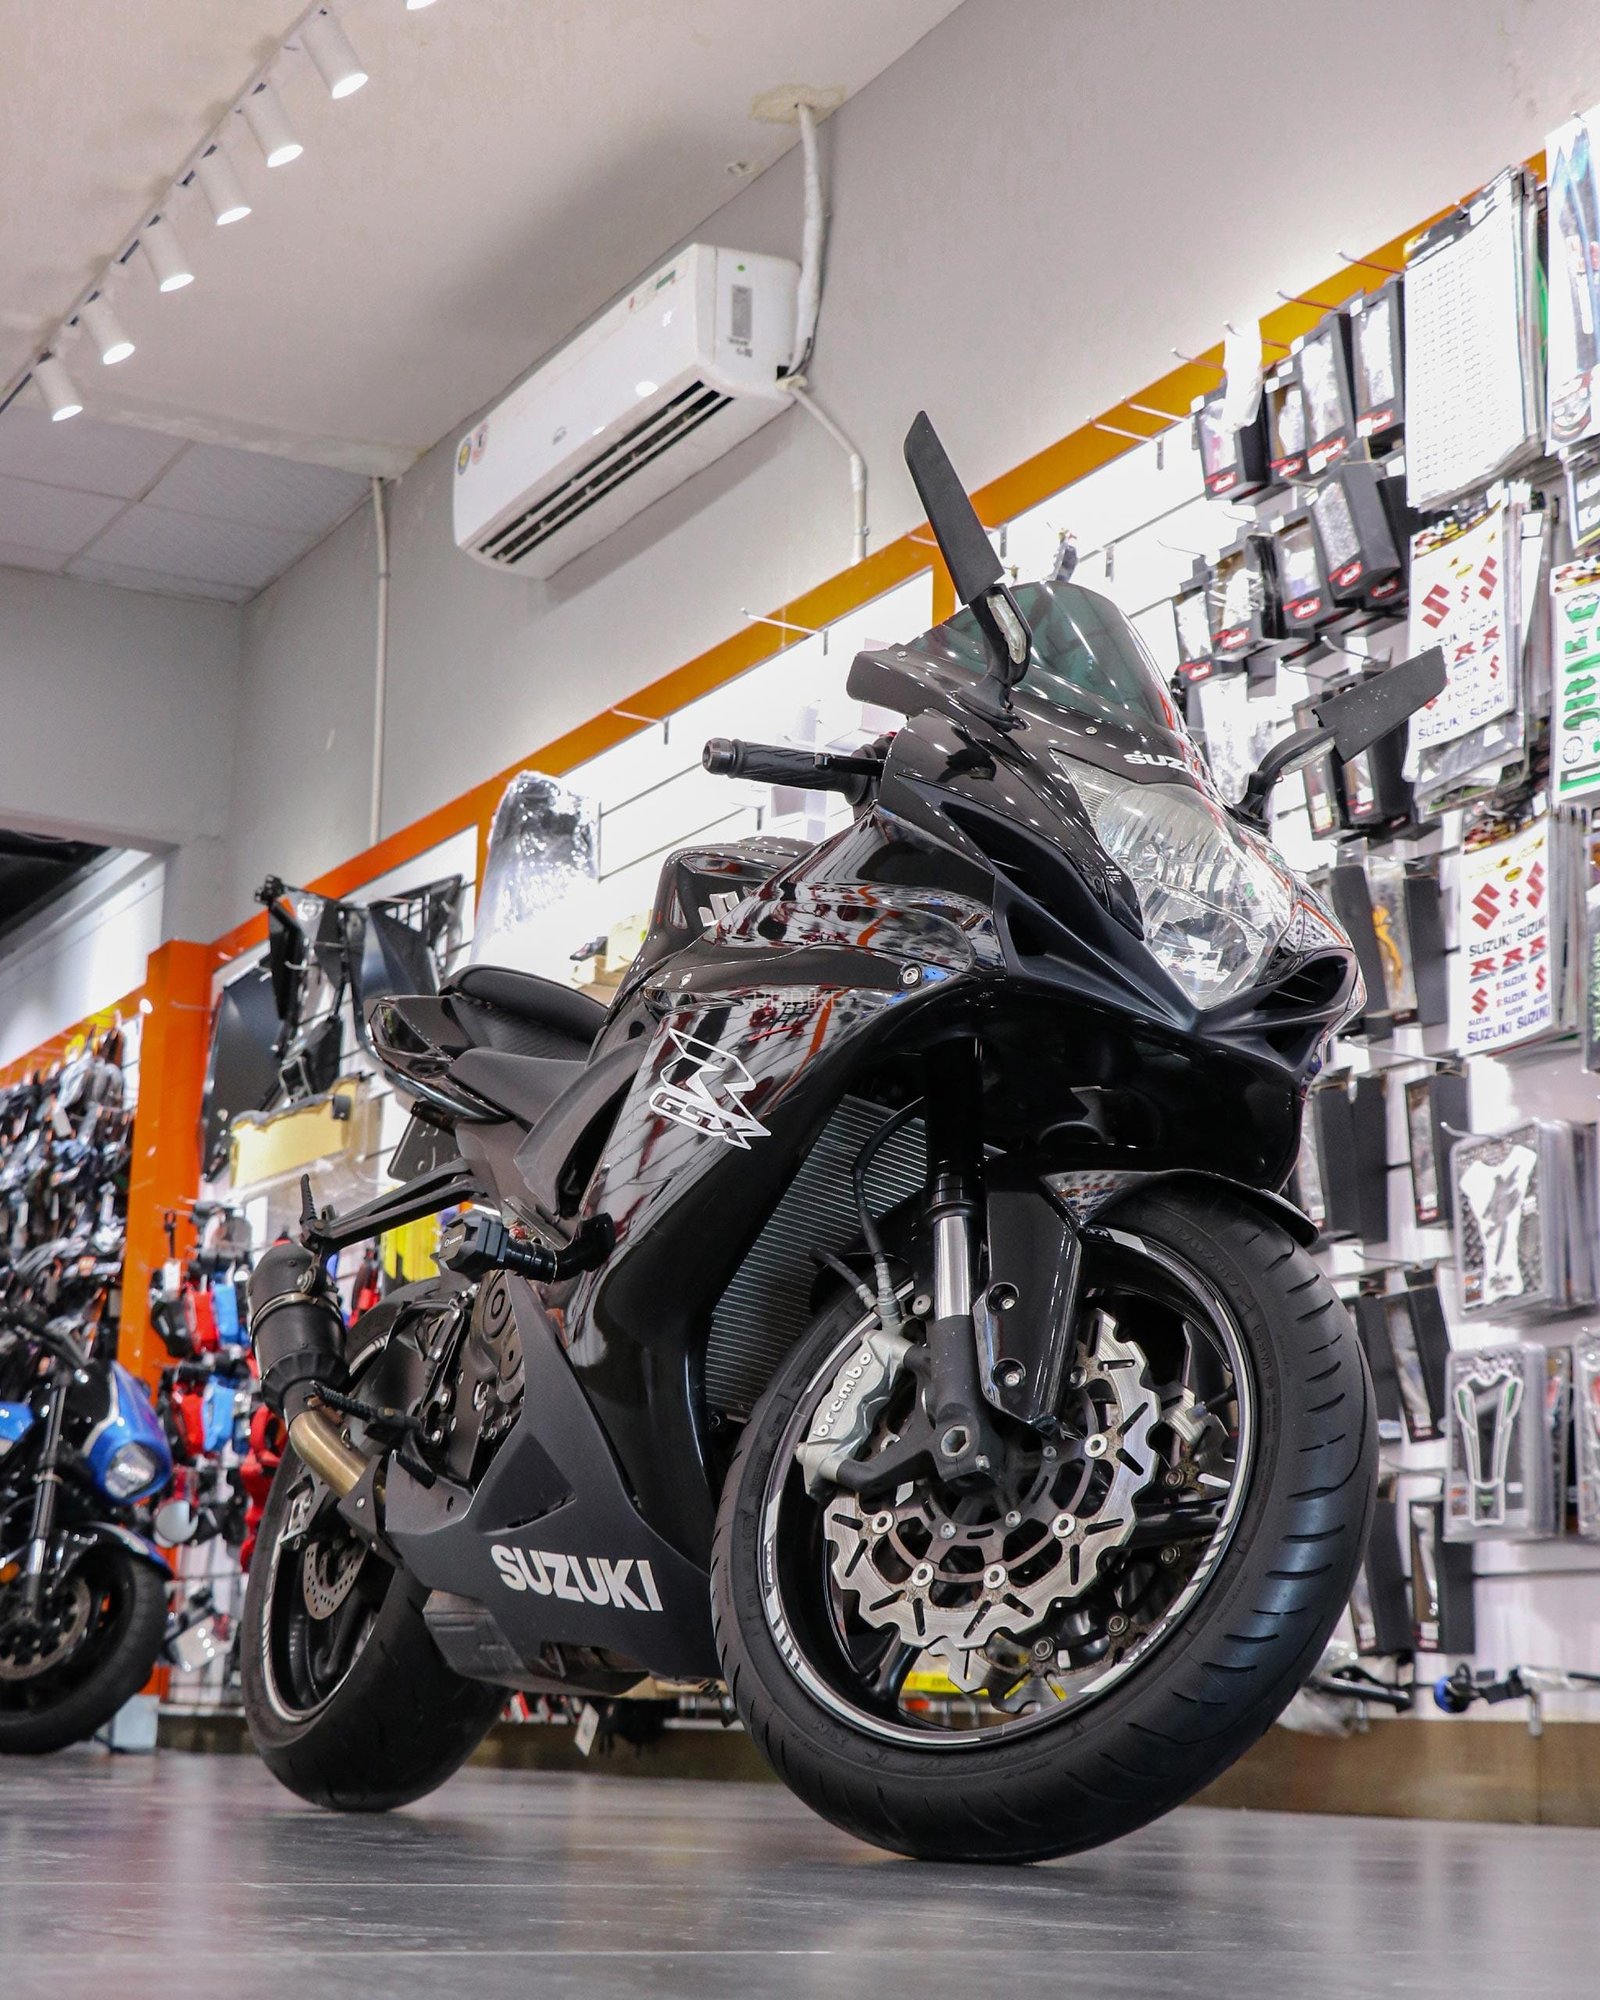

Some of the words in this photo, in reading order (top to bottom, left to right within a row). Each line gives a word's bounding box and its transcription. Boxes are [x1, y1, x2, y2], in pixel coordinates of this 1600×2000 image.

[1468, 933, 1513, 958] SUZUKI
[1466, 1021, 1513, 1045] SUZUKI
[1516, 1006, 1551, 1030] SUZUKI
[812, 1351, 873, 1439] brembo
[490, 1543, 664, 1612] SUZUKI
